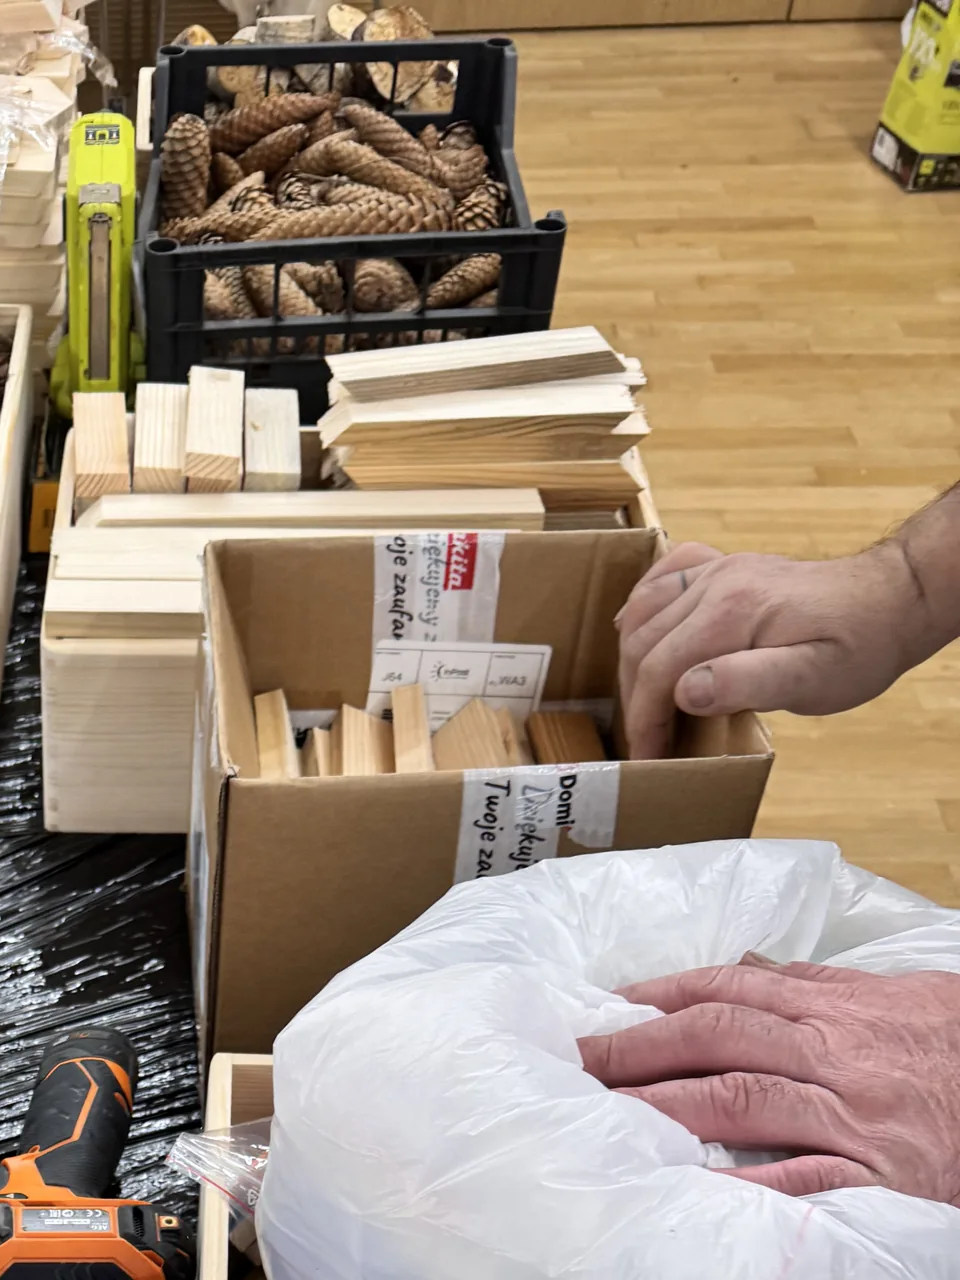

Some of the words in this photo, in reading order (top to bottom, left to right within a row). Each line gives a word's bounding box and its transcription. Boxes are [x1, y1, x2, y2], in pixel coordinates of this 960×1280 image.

[386, 536, 414, 566] oje
[418, 533, 451, 627] iękujemy
[473, 779, 511, 842] Twoje
[476, 848, 494, 879] za
